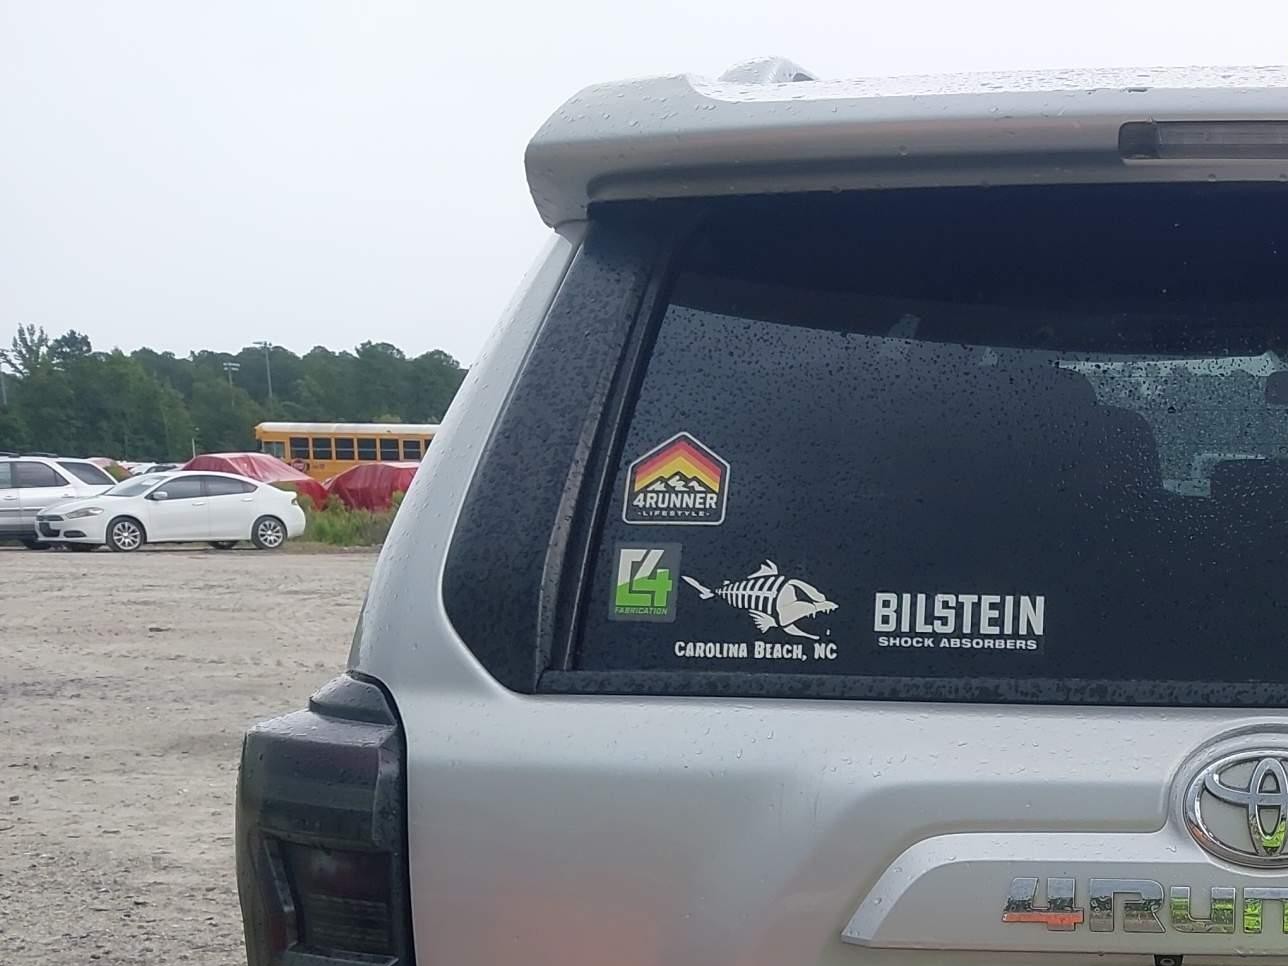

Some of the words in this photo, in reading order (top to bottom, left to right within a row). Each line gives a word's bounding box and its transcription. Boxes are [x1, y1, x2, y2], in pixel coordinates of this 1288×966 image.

[633, 493, 718, 509] 4RUNNER
[615, 607, 668, 615] FABRICATION
[874, 592, 1044, 635] BILSTEIN
[674, 641, 748, 658] CAROLINA
[754, 641, 807, 661] BEACH,
[814, 643, 838, 659] NC
[878, 636, 934, 648] SHOCK
[939, 637, 1037, 650] ABSORBERS
